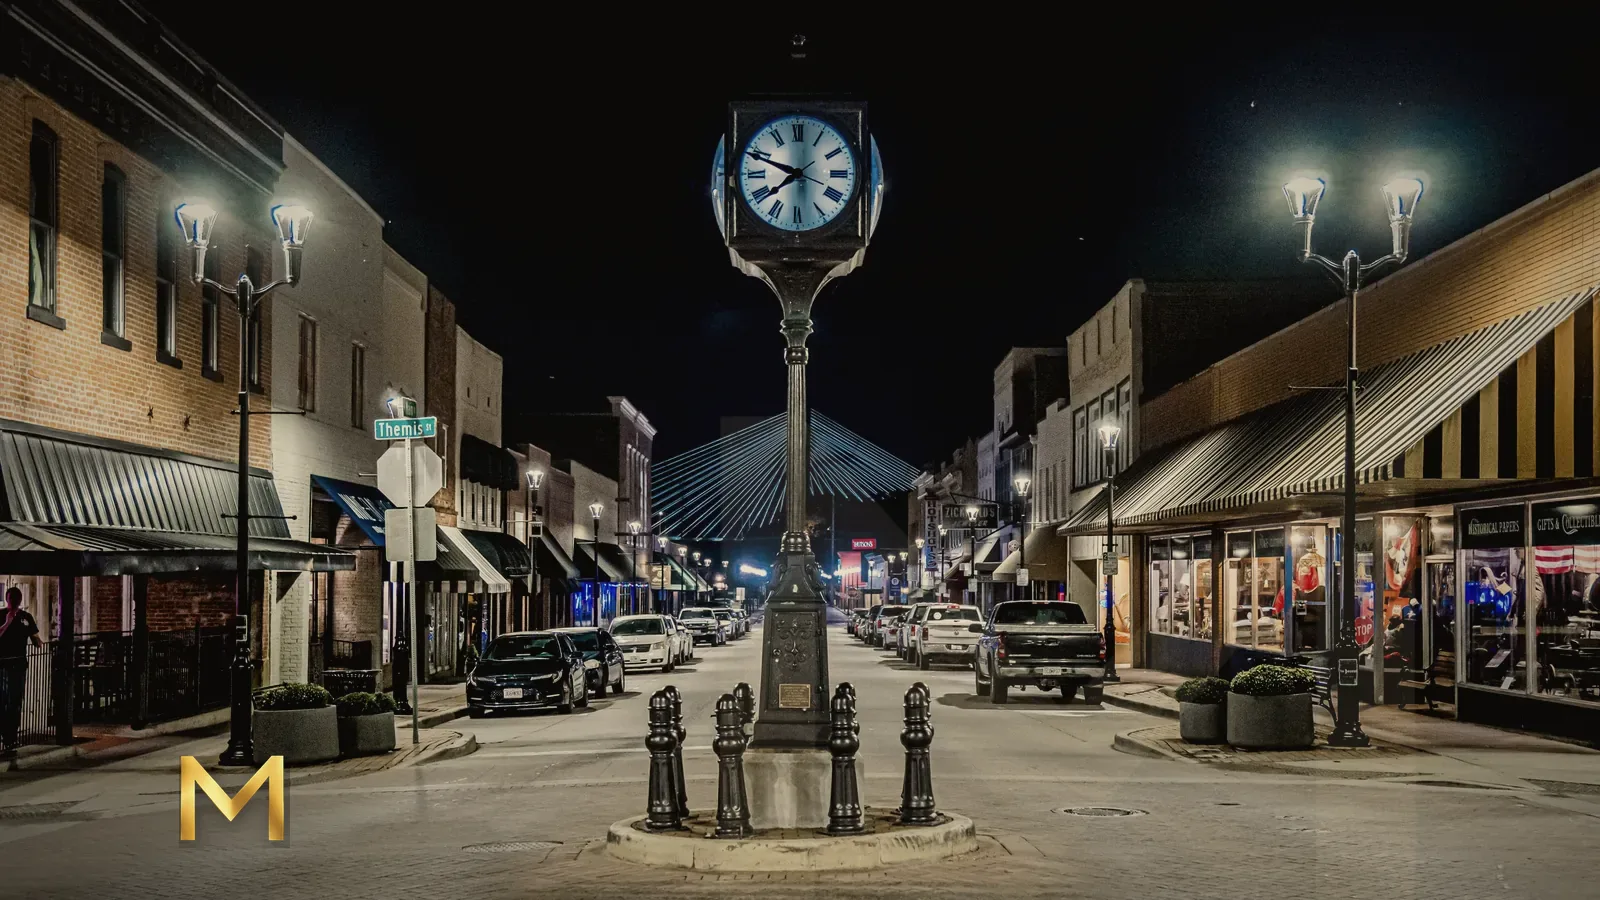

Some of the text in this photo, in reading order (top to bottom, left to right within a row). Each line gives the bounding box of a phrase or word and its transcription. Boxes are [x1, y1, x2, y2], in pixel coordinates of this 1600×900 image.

[770, 129, 785, 148] XI
[792, 124, 804, 142] XII
[813, 130, 824, 147] I
[825, 147, 842, 160] II
[748, 169, 766, 179] IX
[830, 169, 848, 178] III
[768, 200, 784, 219] VII
[793, 206, 802, 223] VI
[379, 421, 423, 437] Themis
[1468, 518, 1520, 535] HISTORICAL PAPERS
[1537, 517, 1555, 531] GIFTS
[1555, 517, 1560, 530] &
